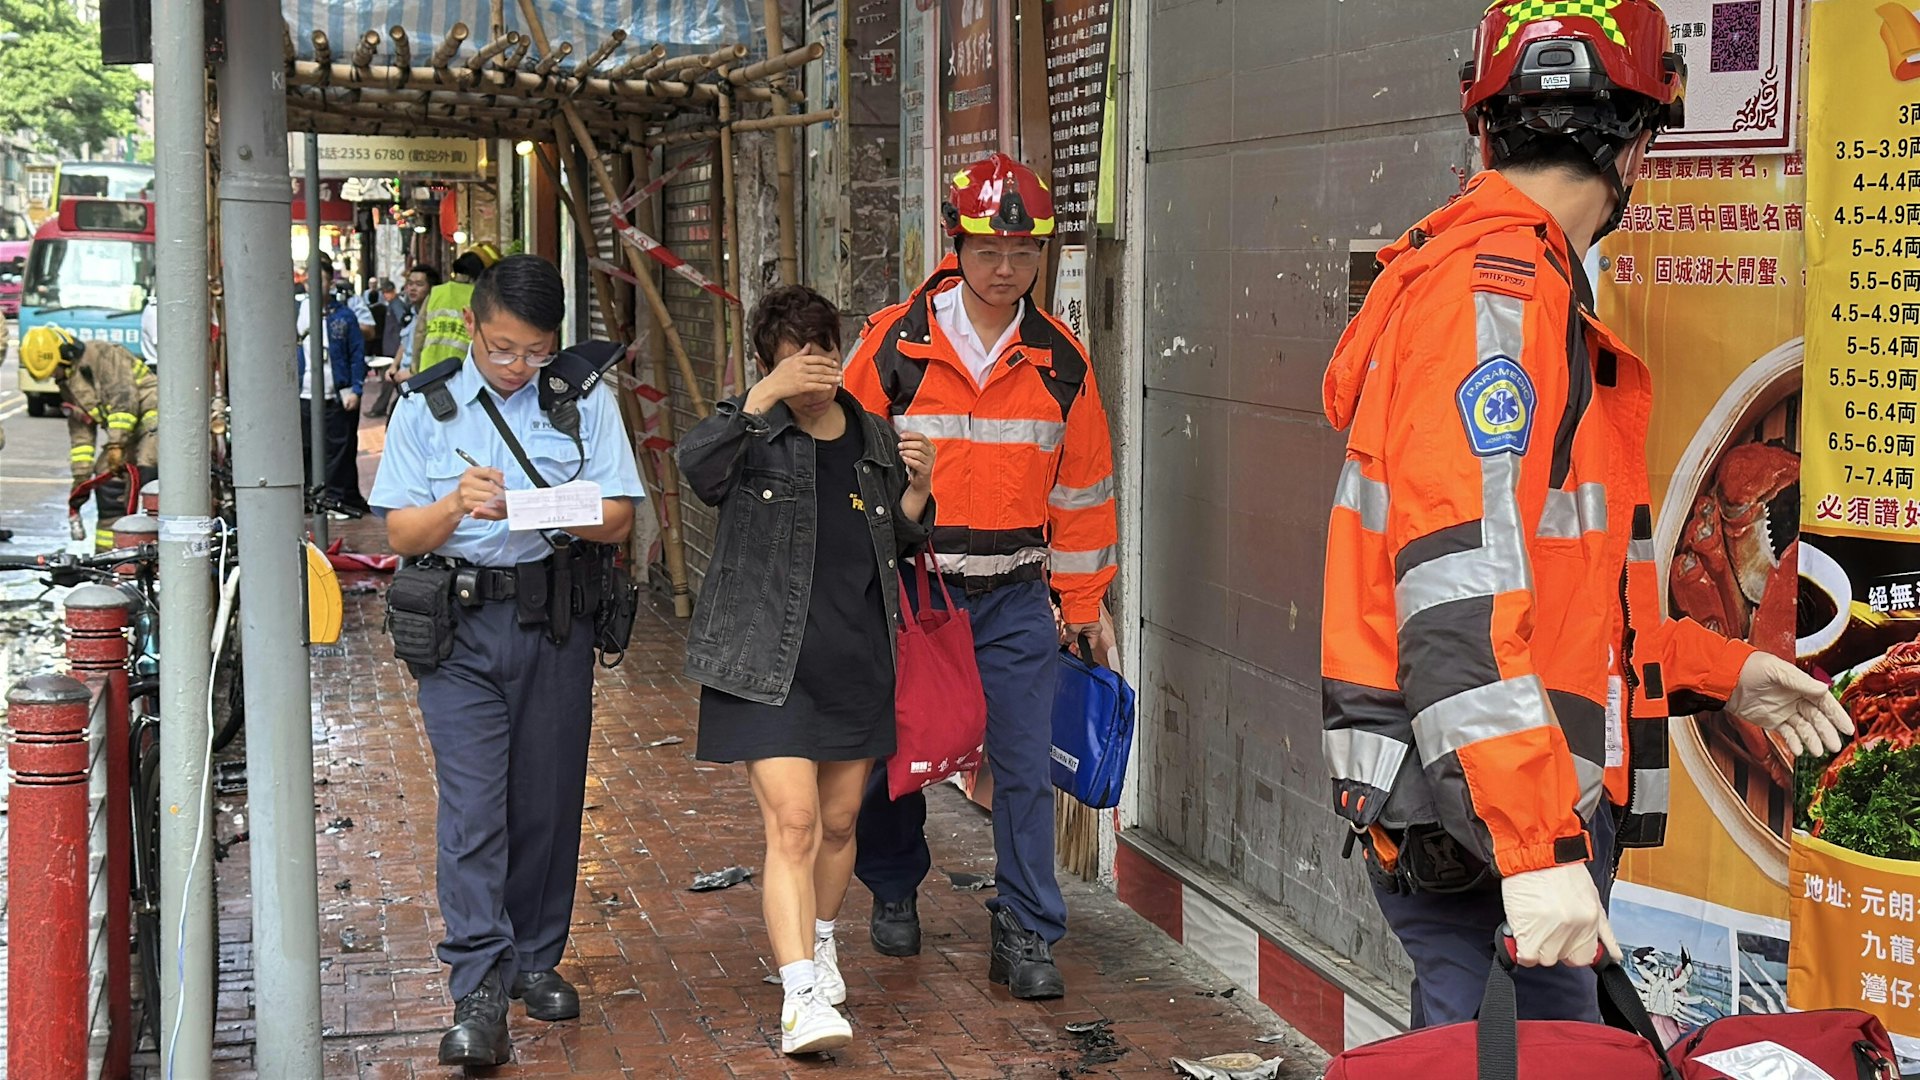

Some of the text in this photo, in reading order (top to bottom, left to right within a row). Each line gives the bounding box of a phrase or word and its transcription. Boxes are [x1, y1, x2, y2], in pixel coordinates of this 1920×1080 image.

[1543, 76, 1569, 85] MSA
[374, 149, 405, 161] 6780
[1615, 256, 1806, 285] 蟹、固城湖大閘蟹、
[581, 370, 599, 391] 60161
[1466, 367, 1531, 400] PARAMEDIC
[1868, 581, 1920, 612] 絕無
[1803, 872, 1920, 922] 地址: 元朗
[1860, 930, 1920, 966] 九龍
[1860, 971, 1920, 1009] 灣仔
